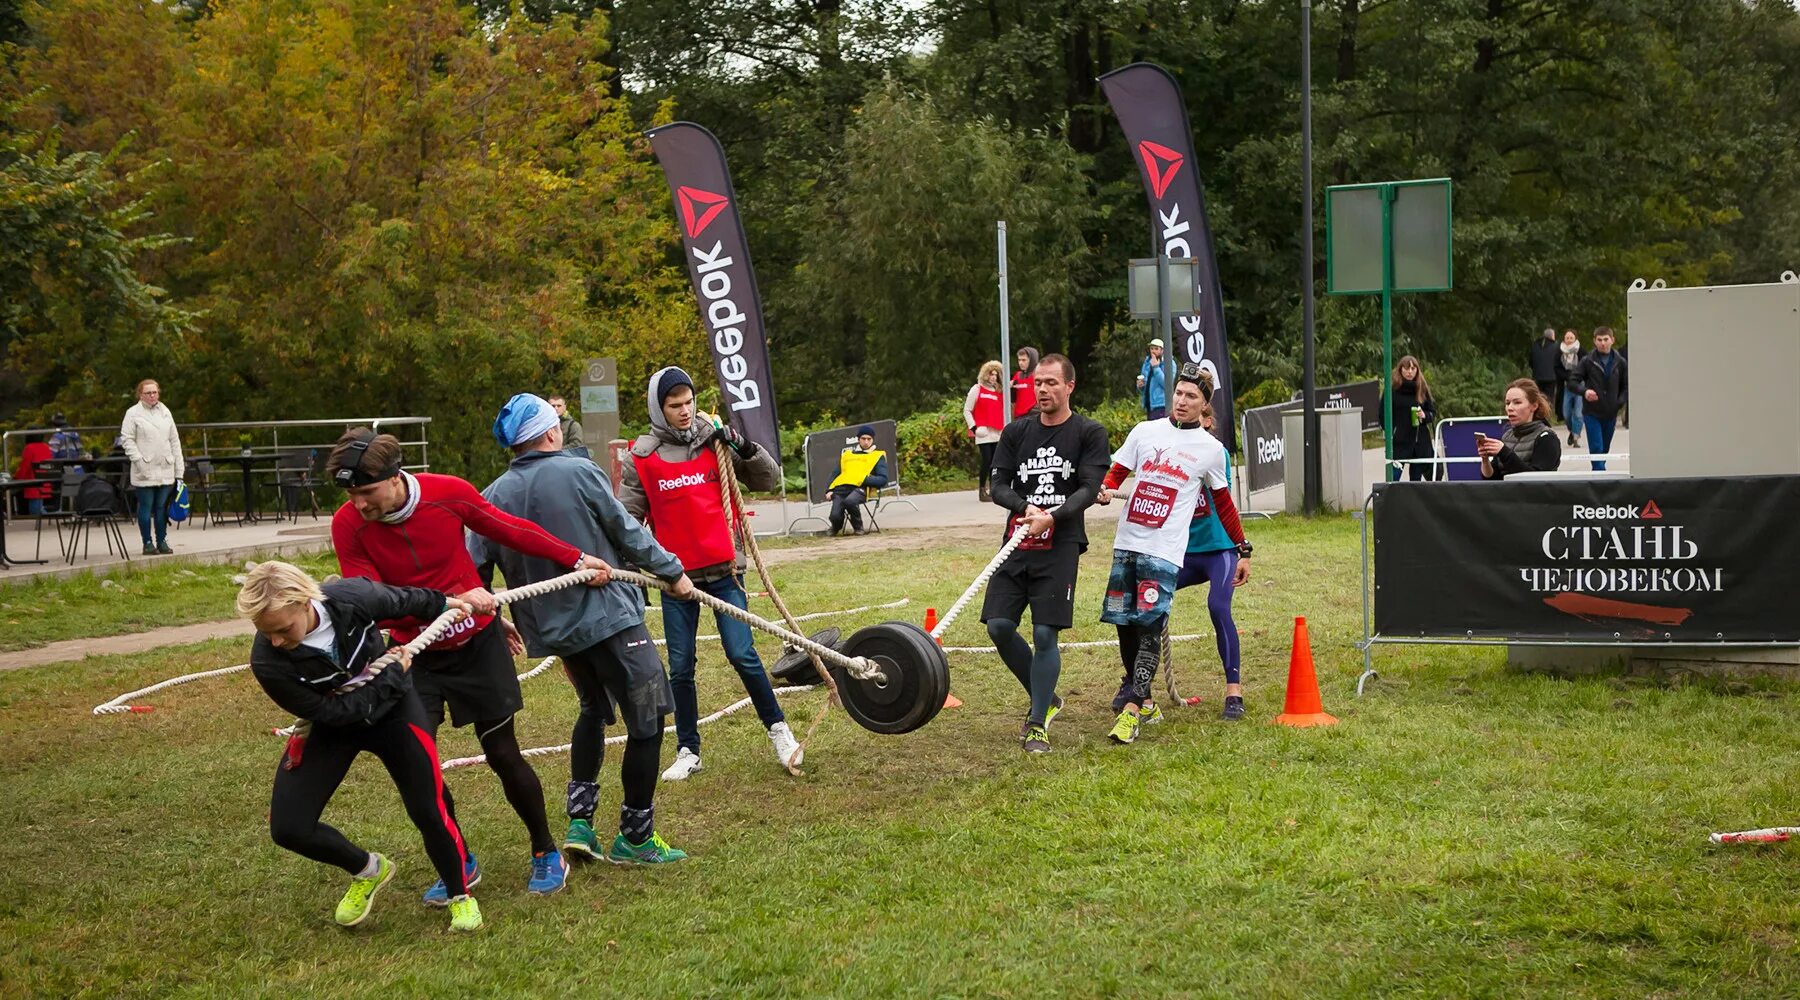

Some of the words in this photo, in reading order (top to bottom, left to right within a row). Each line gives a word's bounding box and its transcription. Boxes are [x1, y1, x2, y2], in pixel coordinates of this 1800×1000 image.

[1036, 446, 1056, 458] GO
[1257, 433, 1284, 464] Reeb
[1027, 456, 1063, 469] HARD
[658, 473, 705, 491] Reebok
[1038, 473, 1054, 485] OR
[1034, 484, 1055, 494] GO
[1132, 497, 1169, 518] R0588
[1572, 504, 1639, 519] Reebok
[1541, 525, 1698, 560] СТАНЬ
[1519, 567, 1724, 592] ЧЕЛОВЕКОМ
